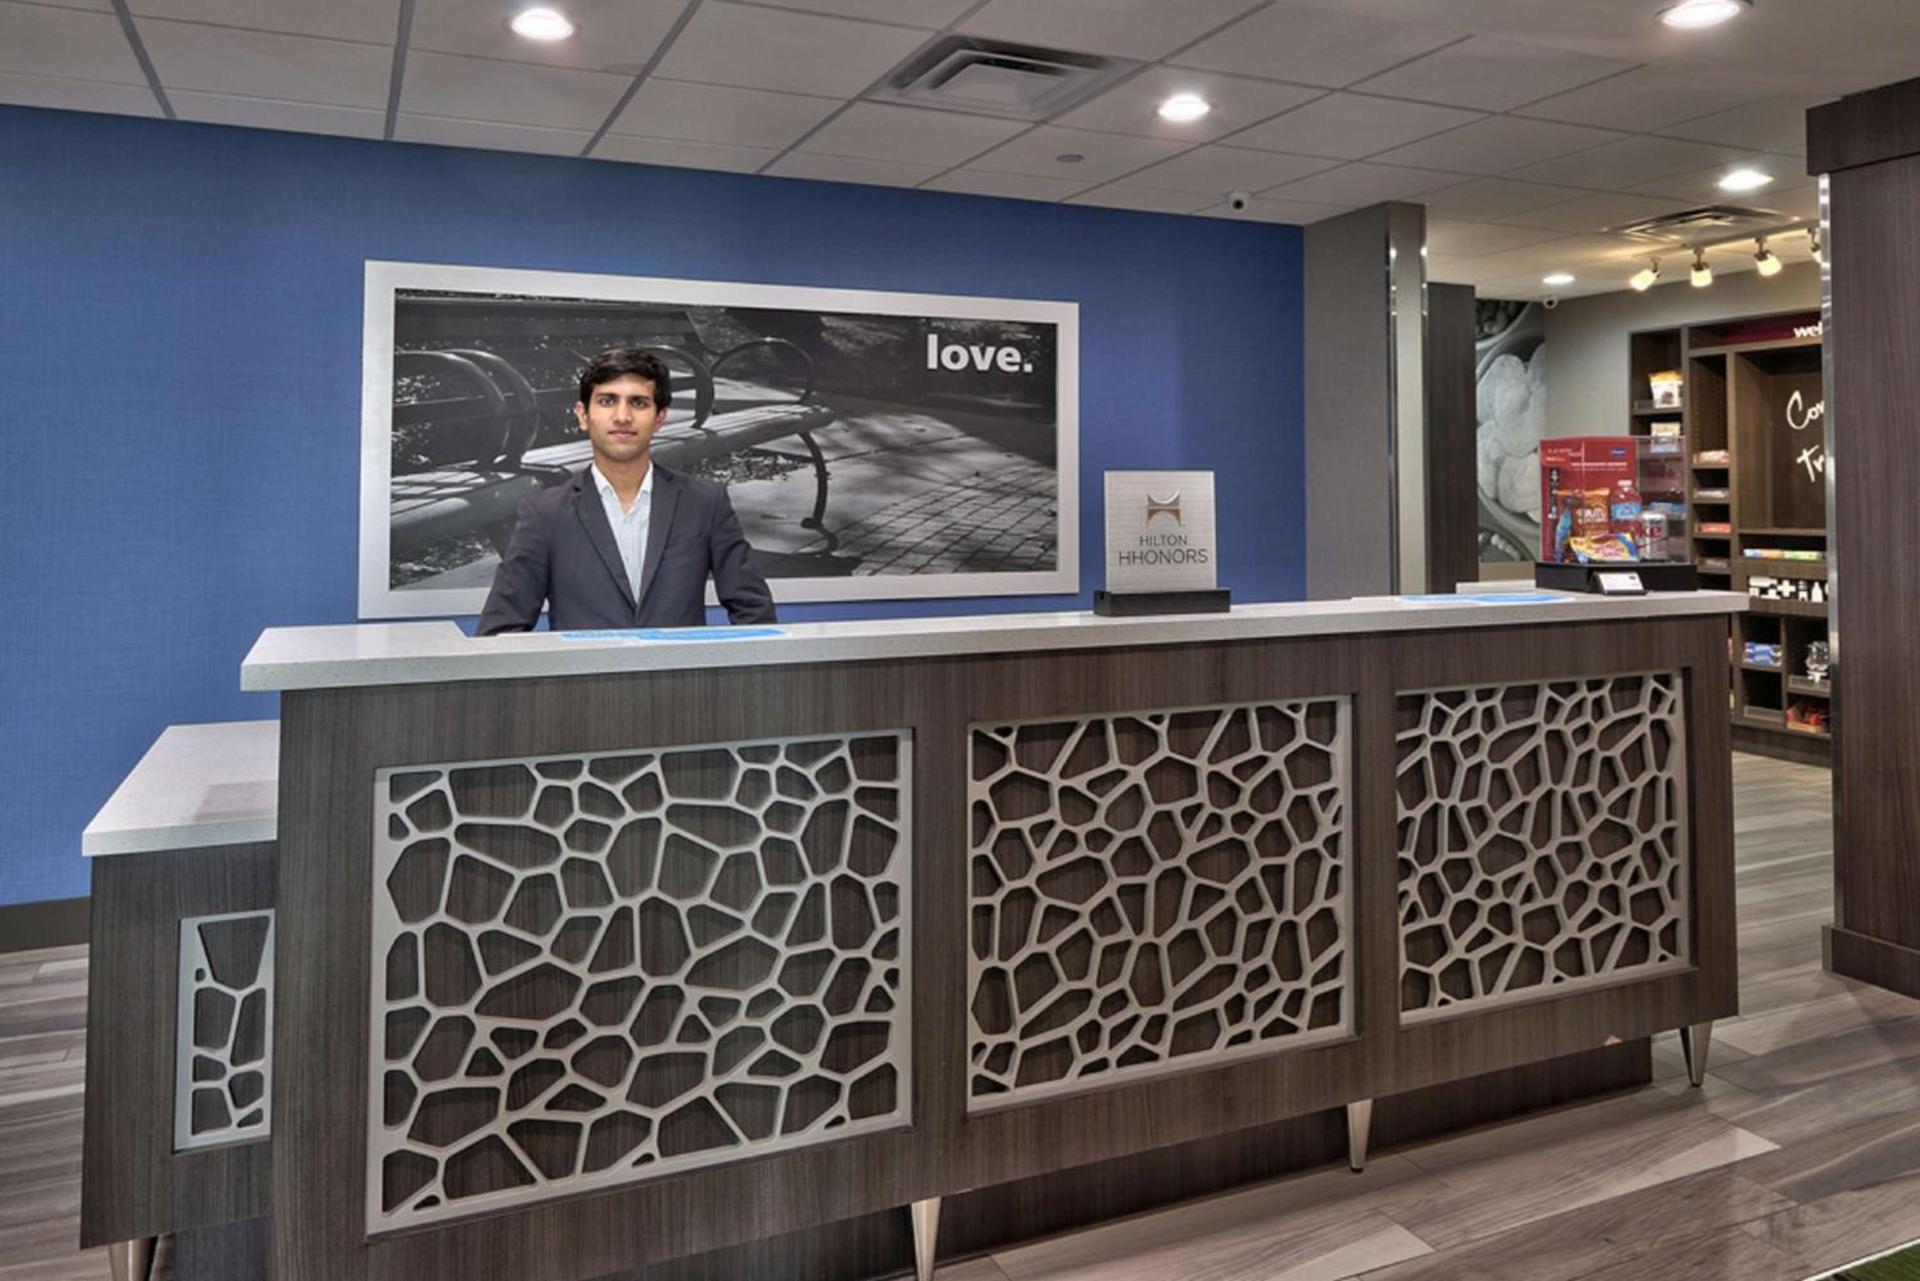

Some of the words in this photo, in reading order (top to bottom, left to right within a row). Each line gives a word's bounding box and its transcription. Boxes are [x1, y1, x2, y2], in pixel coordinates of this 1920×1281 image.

[926, 333, 1033, 373] love.
[1139, 534, 1188, 547] HILTON
[1118, 548, 1208, 566] HHONORS
